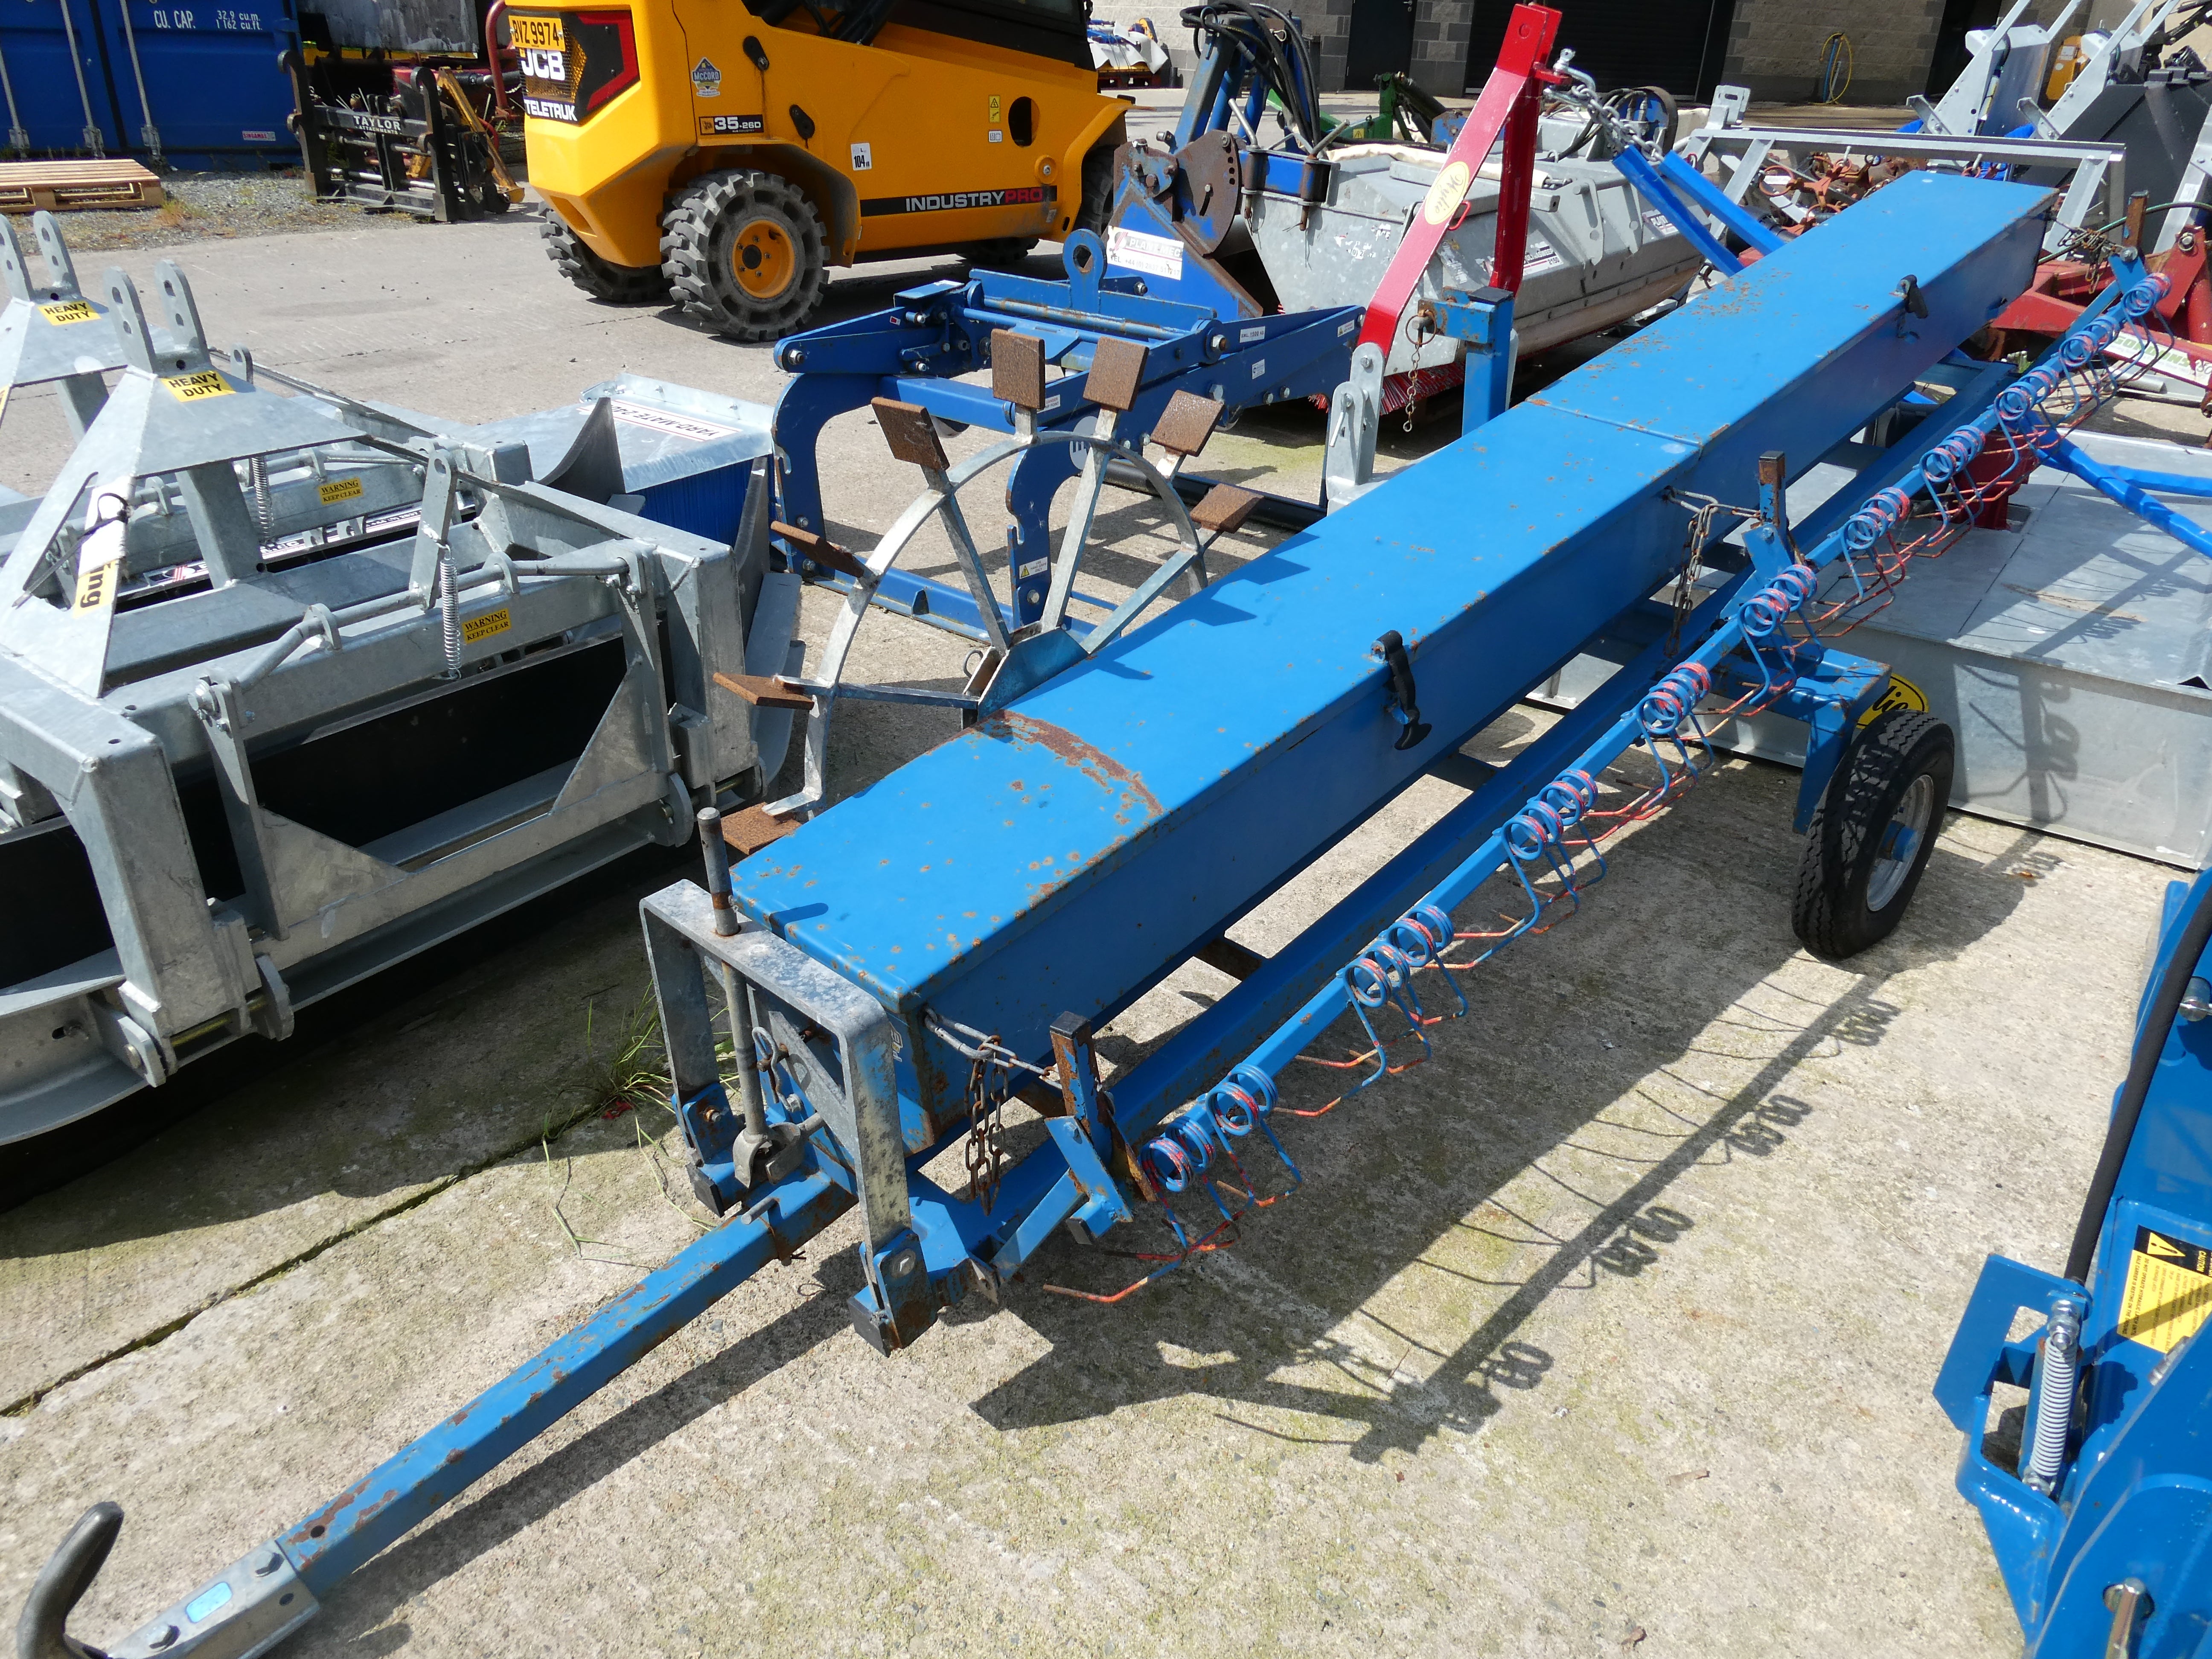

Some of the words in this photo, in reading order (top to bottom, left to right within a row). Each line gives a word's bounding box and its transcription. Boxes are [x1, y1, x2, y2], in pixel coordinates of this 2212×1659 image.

[154, 10, 171, 28] CU.
[173, 10, 196, 29] CAP.
[512, 20, 530, 44] BVZ
[530, 21, 559, 47] 9974
[520, 48, 565, 81] JCB
[523, 99, 578, 121] TELETRUK
[353, 115, 401, 131] TAYLOR
[854, 155, 865, 168] 104
[44, 303, 87, 315] HEAVY
[55, 310, 90, 321] DUTY
[168, 373, 218, 388] HEAVY
[182, 383, 222, 397] DUTY
[611, 405, 630, 415] 240
[633, 413, 720, 437] YARD-MATE
[321, 480, 359, 494] WARNING
[323, 494, 340, 502] KEEP
[340, 489, 361, 498] CLEAR
[465, 611, 506, 630] WARNING
[467, 629, 485, 640] KEEP
[486, 621, 509, 634] CLEAR
[2196, 1250, 2207, 1272] CAUTION
